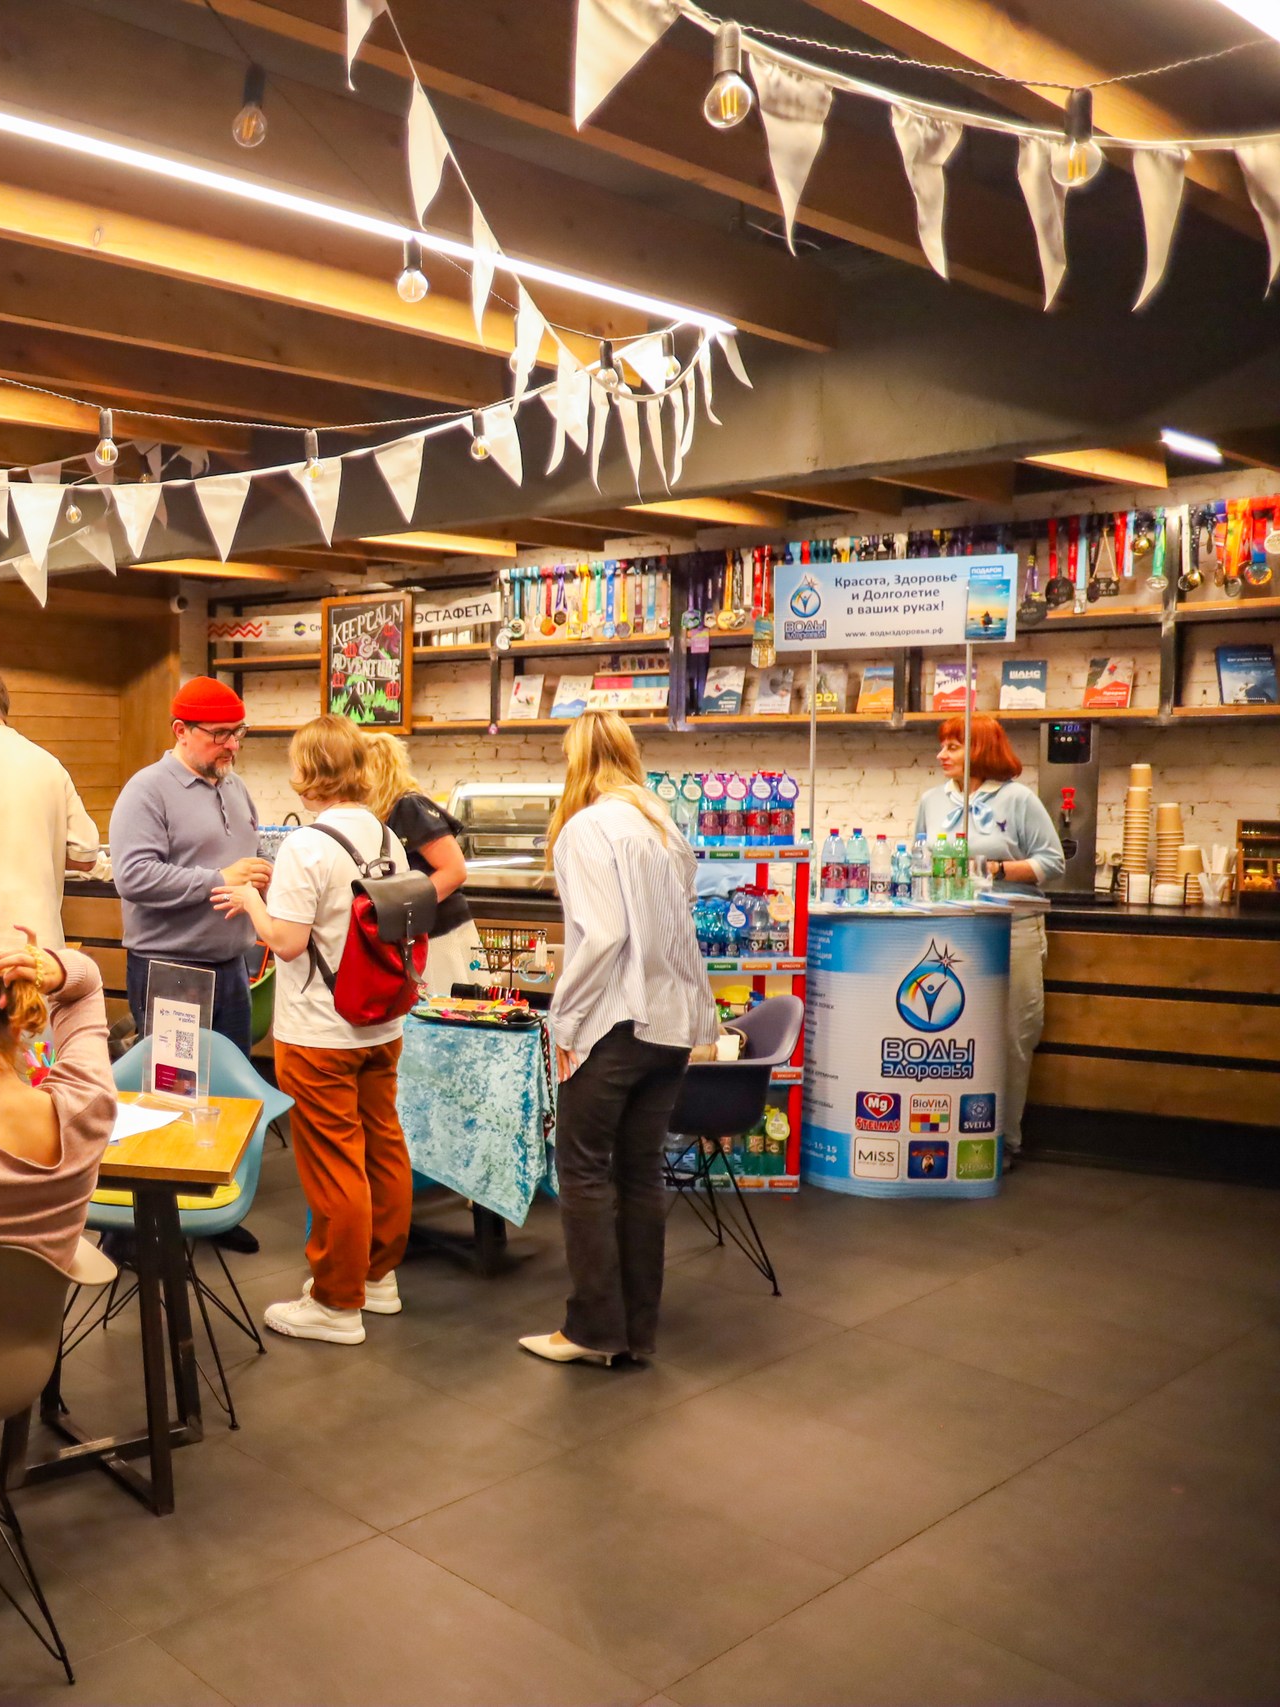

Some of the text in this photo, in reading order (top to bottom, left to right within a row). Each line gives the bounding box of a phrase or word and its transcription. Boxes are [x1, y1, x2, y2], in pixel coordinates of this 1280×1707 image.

[835, 573, 958, 588] Красота, Здоровье
[851, 587, 940, 602] и Долголетие
[414, 603, 493, 625] ЭСТАФЕТА
[857, 605, 899, 615] ваших
[903, 601, 944, 616] руках!
[310, 623, 322, 632] Сп
[333, 614, 366, 648] KEEP
[785, 620, 827, 633] ВОДЫ
[358, 632, 380, 658] &
[332, 653, 401, 680] ADVENTURE
[357, 680, 376, 696] ON
[881, 1037, 974, 1063] ВОДЫ
[868, 1096, 888, 1112] Mg
[913, 1099, 949, 1108] BioVitA
[855, 1116, 900, 1132] STELMAS
[963, 1121, 992, 1130] SVETLA
